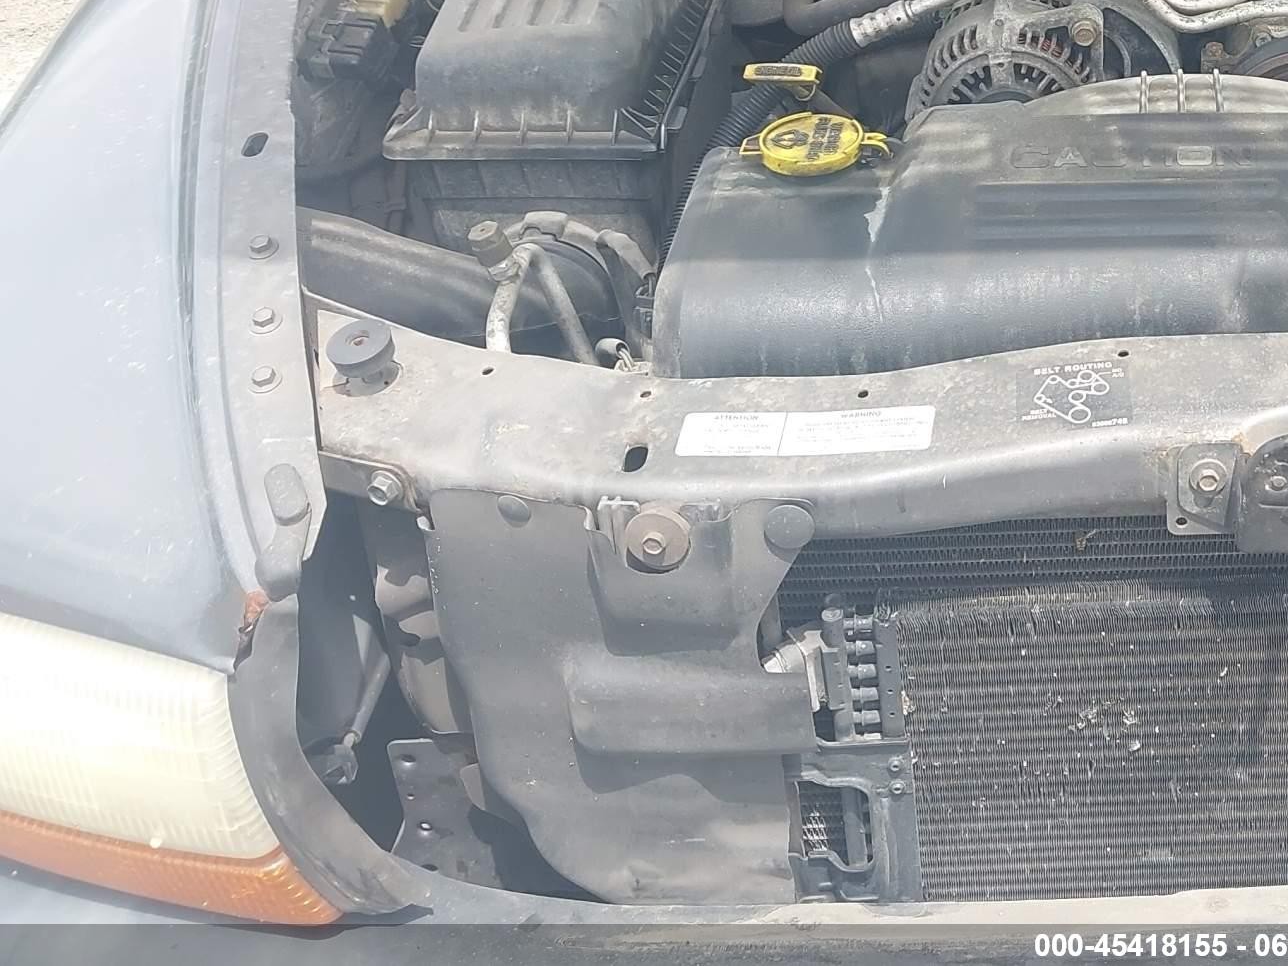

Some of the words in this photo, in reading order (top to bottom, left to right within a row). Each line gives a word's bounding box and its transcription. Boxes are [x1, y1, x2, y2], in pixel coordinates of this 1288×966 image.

[1009, 141, 1258, 170] CAUTION
[1033, 366, 1060, 375] BELT
[1064, 361, 1113, 372] ROUTING
